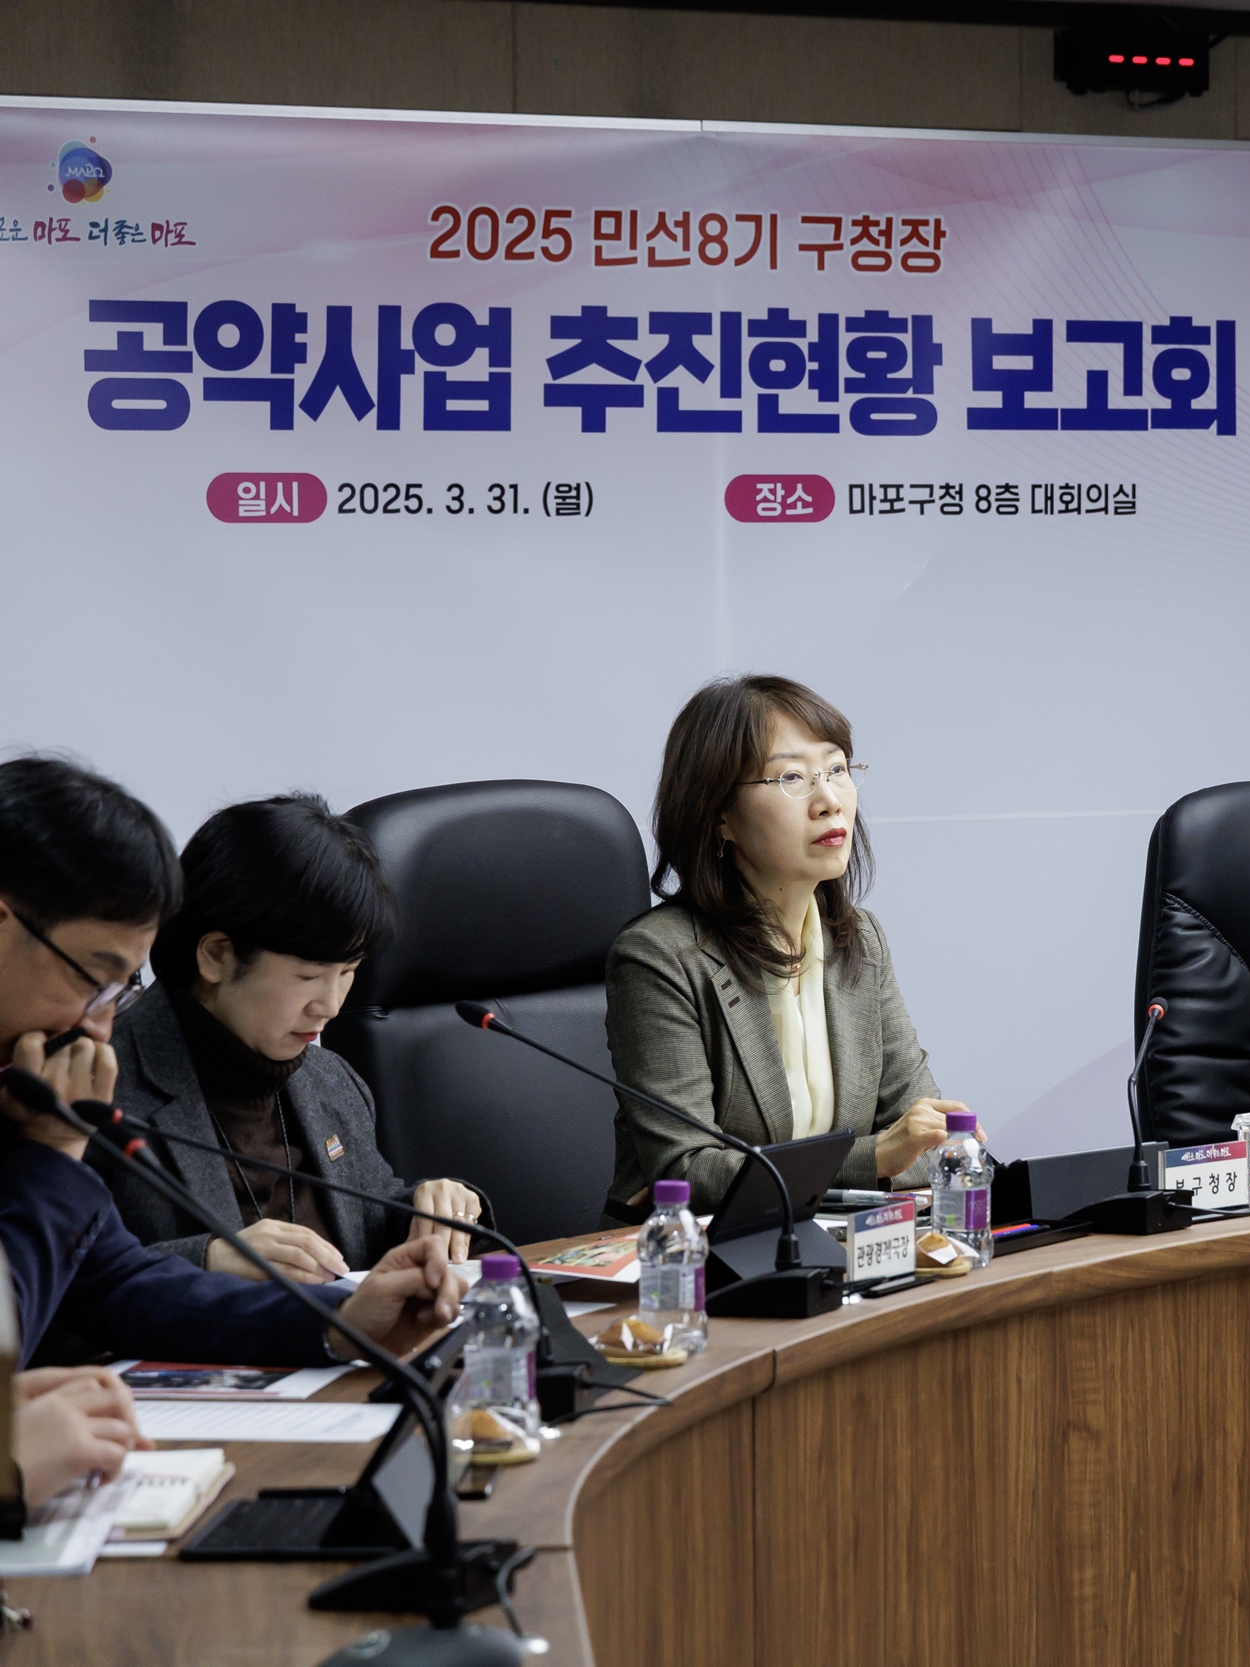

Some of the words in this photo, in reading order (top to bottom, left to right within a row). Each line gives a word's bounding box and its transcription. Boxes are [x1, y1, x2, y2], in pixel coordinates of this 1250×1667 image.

[65, 164, 105, 178] MAPO
[33, 217, 81, 245] 마포
[88, 218, 108, 246] 더
[113, 220, 147, 245] 좋은
[151, 220, 197, 247] 마포
[430, 206, 572, 262] 2025
[594, 210, 778, 269] 민선8기
[799, 215, 947, 273] 구청장
[84, 300, 512, 431] 공약사업
[544, 305, 942, 436] 추진현황
[967, 316, 1237, 436] 보고회
[237, 481, 299, 516] 일시
[338, 483, 433, 514] 2025.
[446, 483, 474, 514] 3.
[487, 483, 529, 514] 31.
[543, 482, 593, 517] (월)
[756, 483, 814, 516] 장소
[849, 483, 964, 515] 마포구청
[975, 483, 1020, 515] 8층
[1031, 483, 1137, 515] 대회의실
